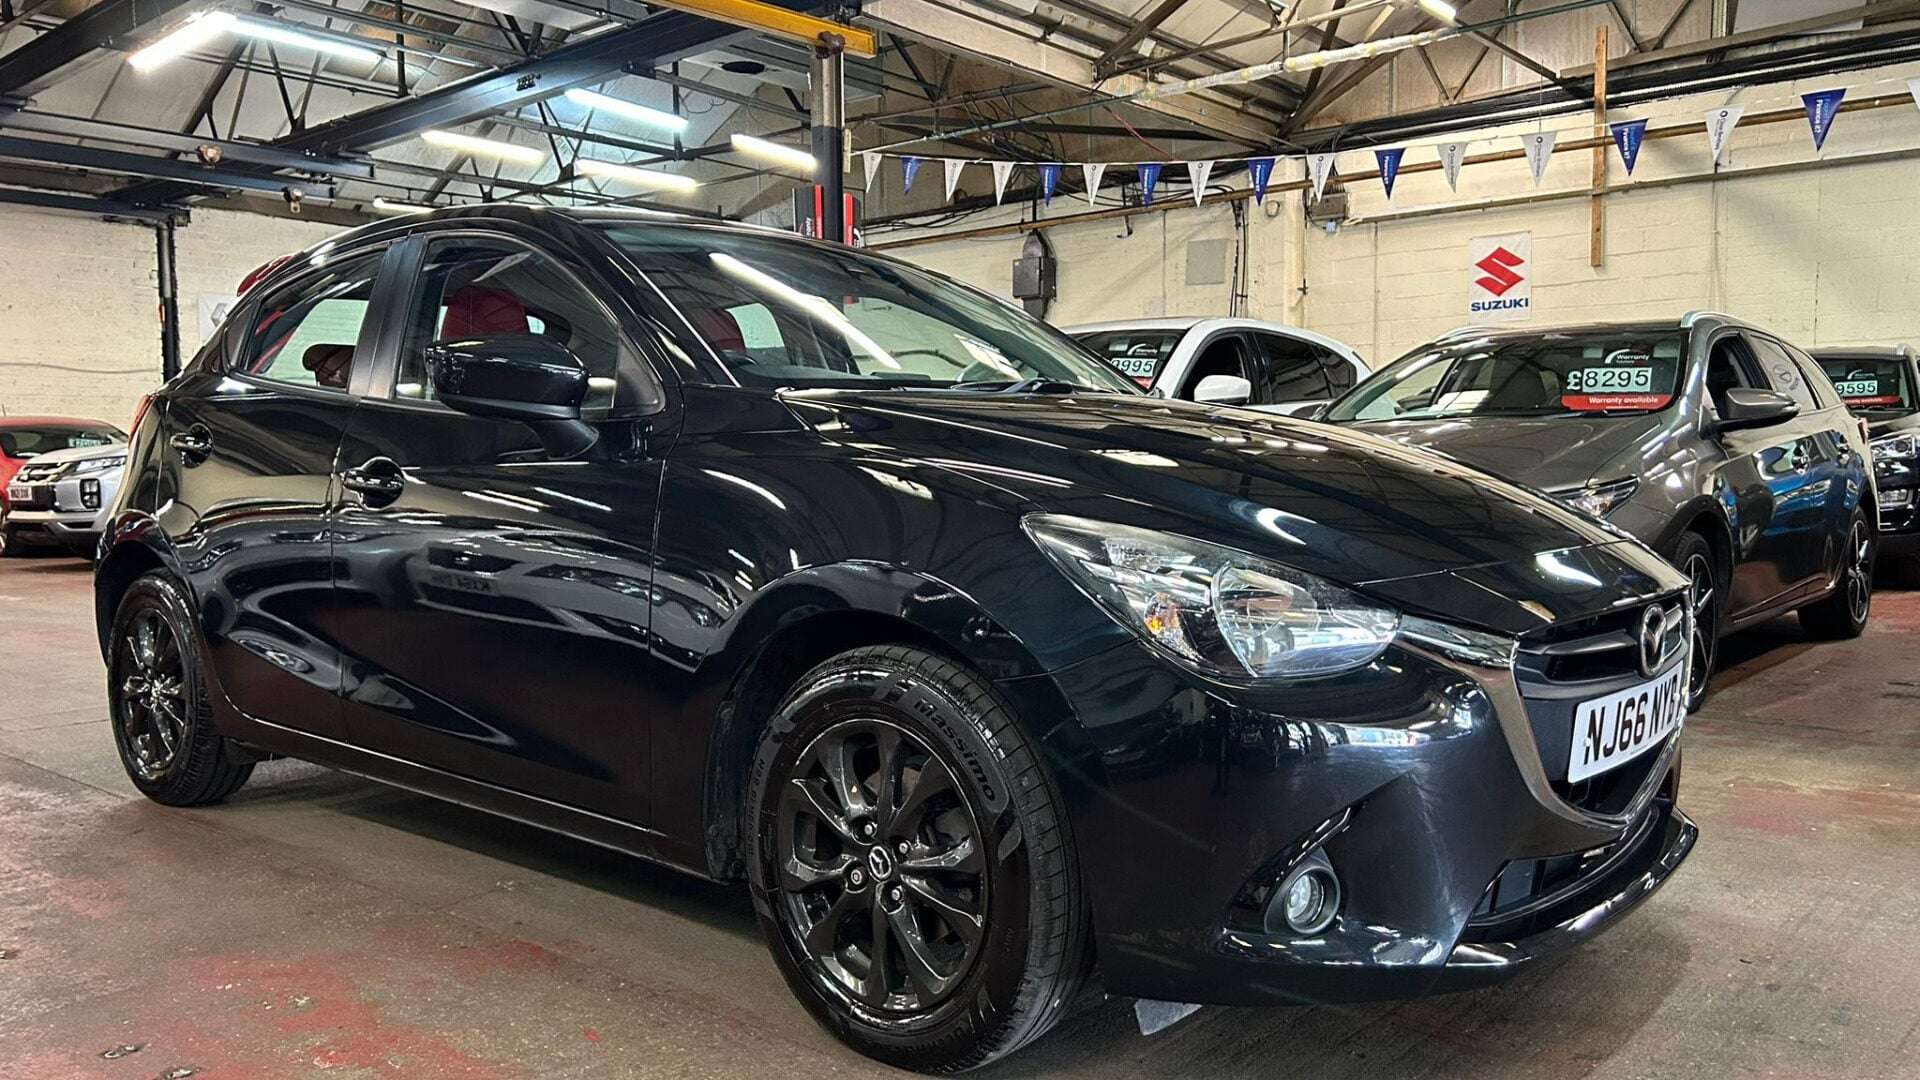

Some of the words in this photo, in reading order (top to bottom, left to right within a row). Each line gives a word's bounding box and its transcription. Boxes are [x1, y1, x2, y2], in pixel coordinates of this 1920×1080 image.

[1471, 298, 1529, 312] SUZUKI
[1566, 370, 1649, 390] £8295
[1836, 382, 1876, 394] 9595
[1588, 396, 1622, 405] Warranty
[1624, 396, 1658, 404] available
[1583, 692, 1648, 765] NJ66
[914, 697, 996, 801] Massimo
